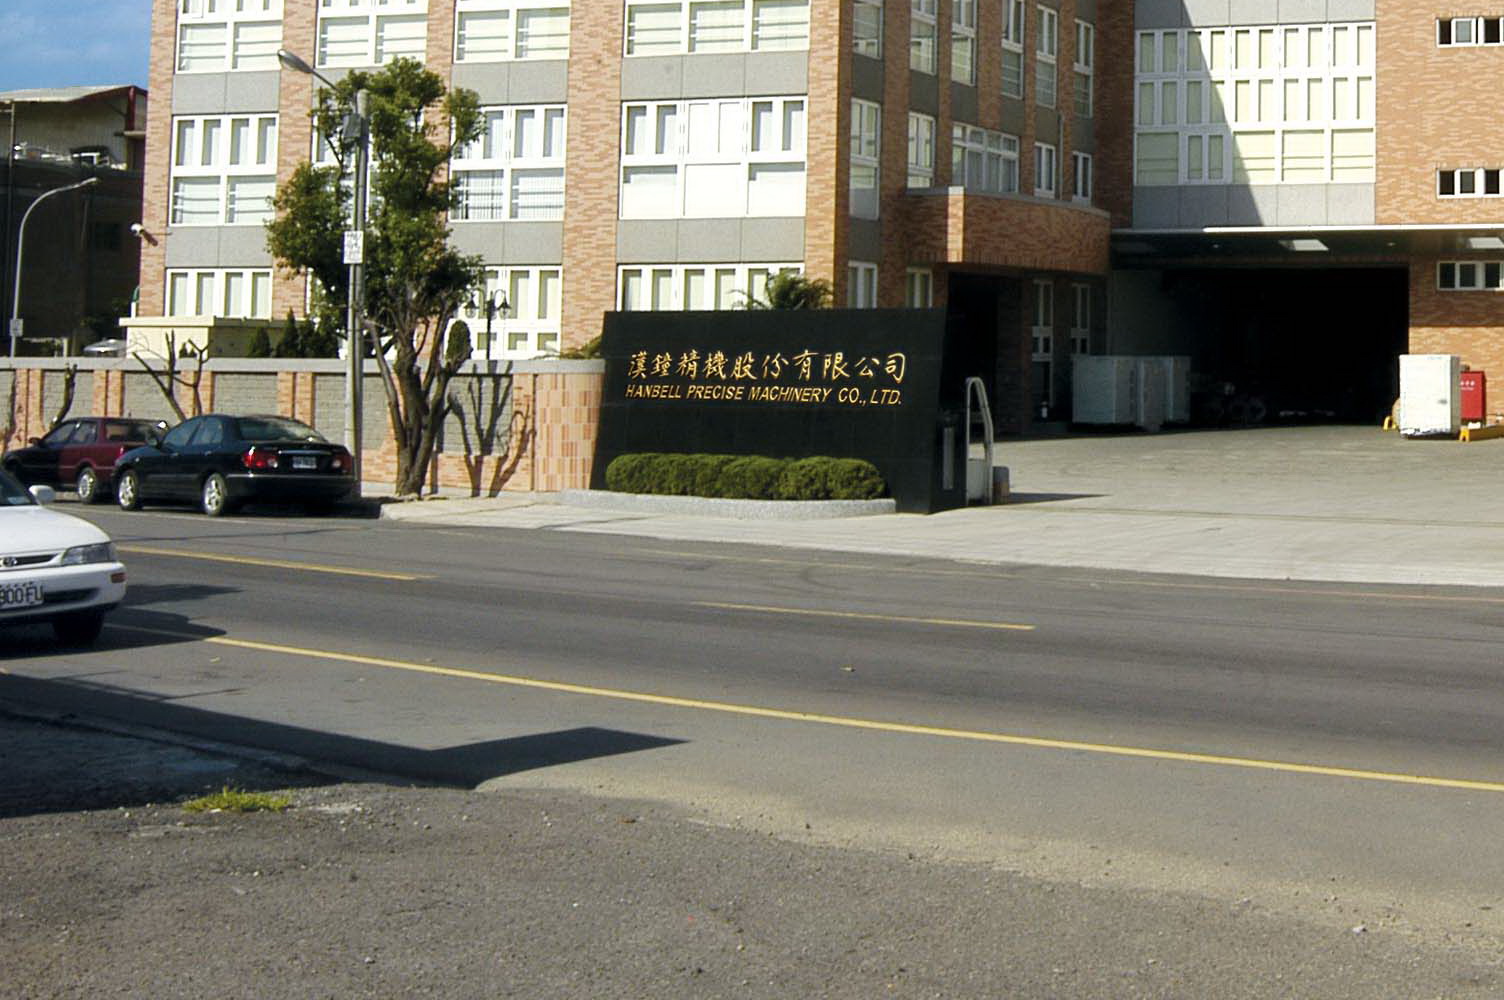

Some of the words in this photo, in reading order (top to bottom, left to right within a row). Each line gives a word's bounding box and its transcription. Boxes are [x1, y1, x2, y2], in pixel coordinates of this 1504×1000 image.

[627, 349, 906, 383] 漢鐘精機股份有限公司
[625, 384, 682, 399] HANBELL
[686, 385, 745, 400] PRECISE
[748, 386, 833, 402] MACHINERY
